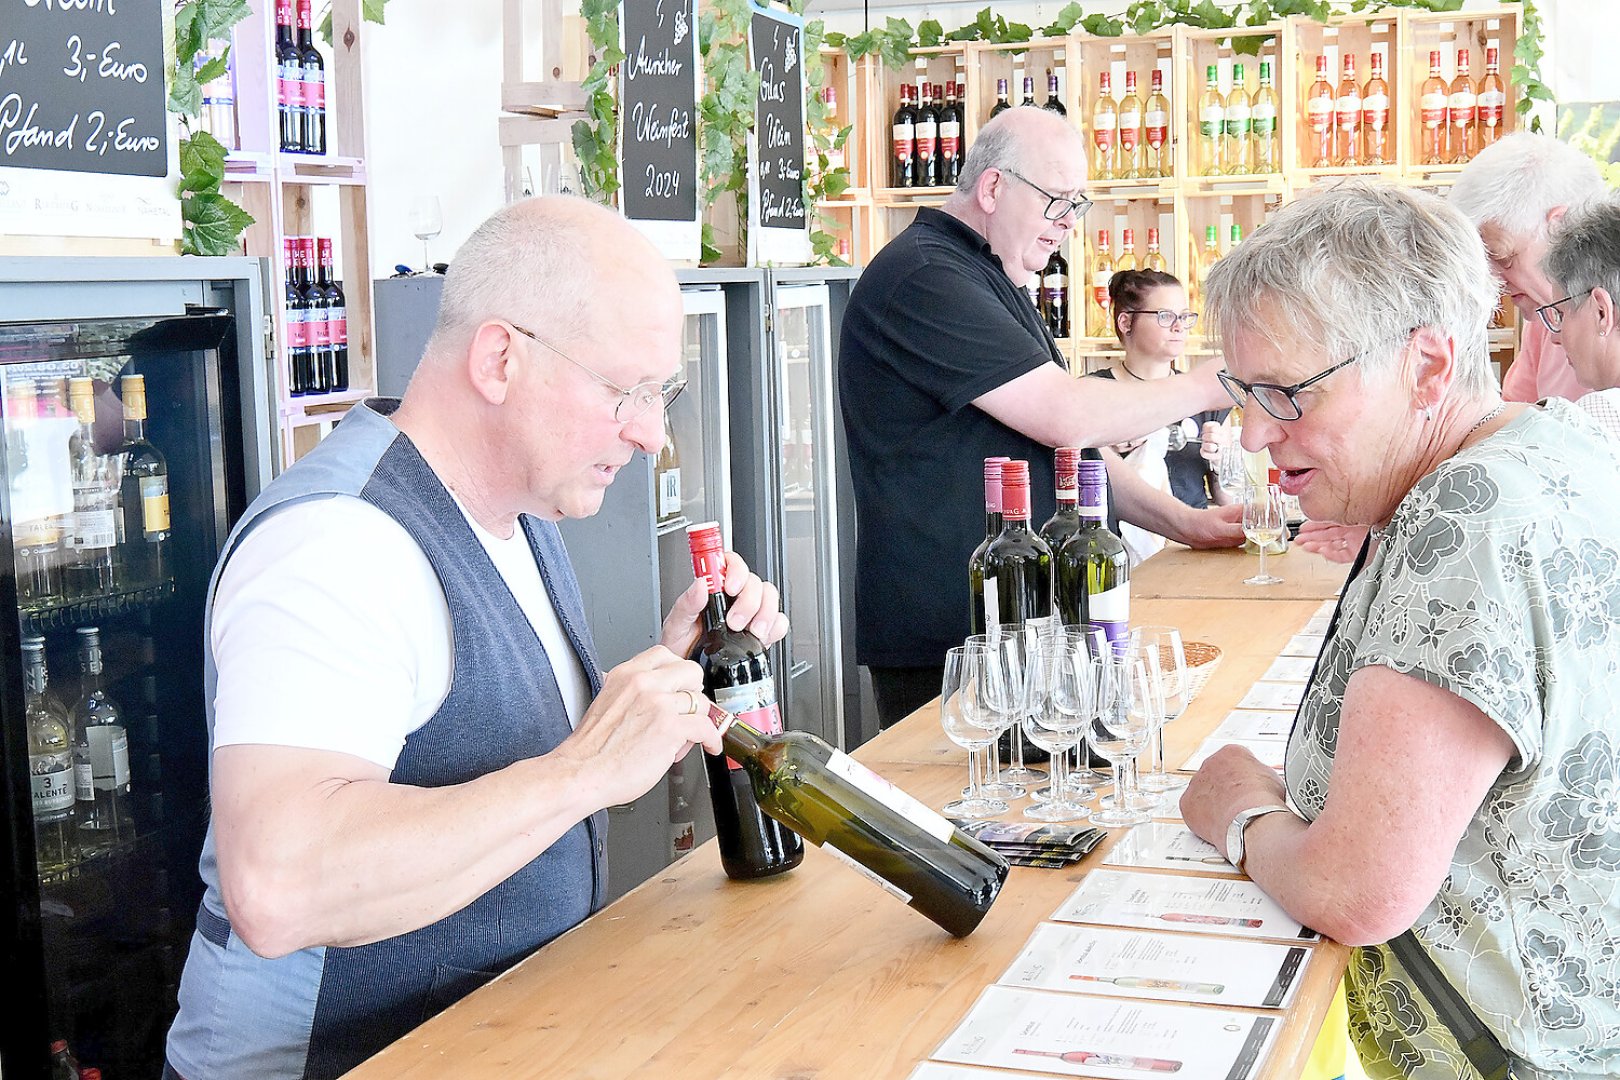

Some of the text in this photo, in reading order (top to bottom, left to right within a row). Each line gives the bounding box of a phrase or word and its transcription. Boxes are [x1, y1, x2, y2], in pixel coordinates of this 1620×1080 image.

[98, 42, 148, 83] Euro
[628, 35, 683, 81] Auricher
[759, 56, 786, 103] Glas
[0, 93, 80, 156] Pfand
[114, 117, 160, 152] Euro
[632, 102, 690, 149] Weinfest
[766, 112, 792, 149] Wein
[645, 163, 681, 199] 2024
[760, 188, 785, 223] Pfand
[43, 777, 52, 789] 3
